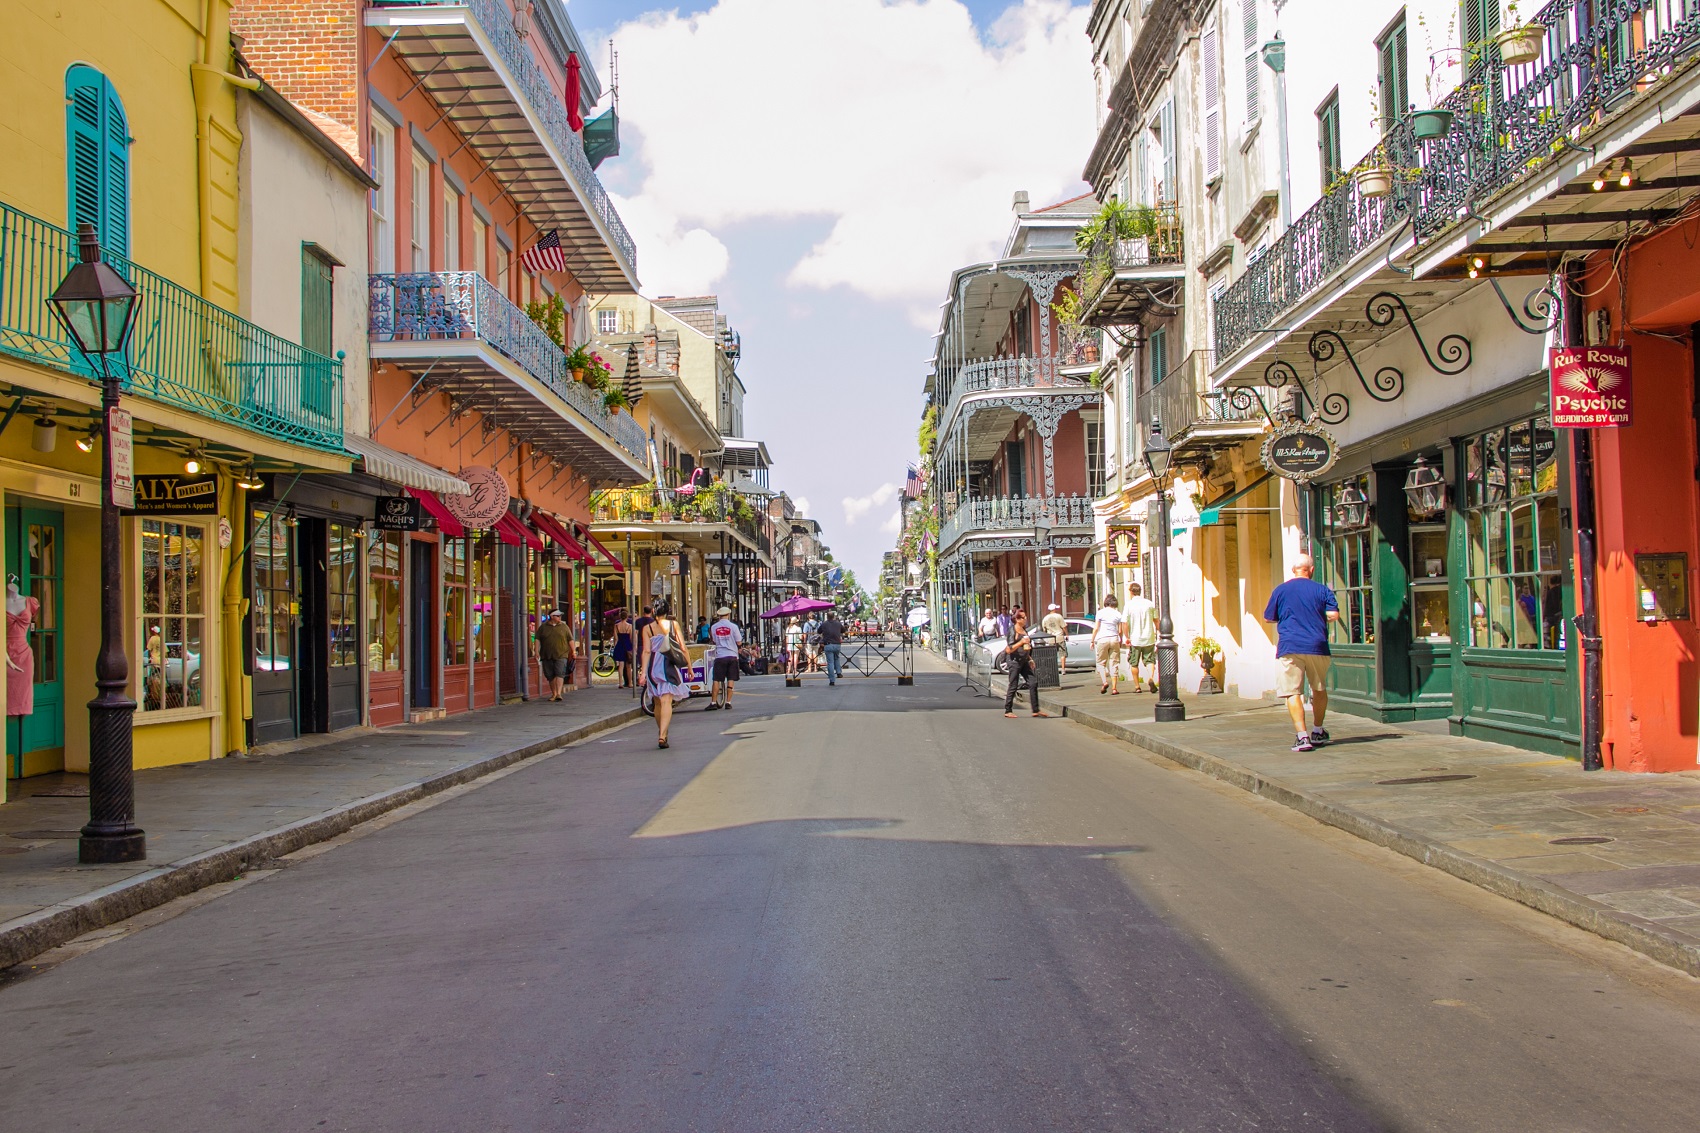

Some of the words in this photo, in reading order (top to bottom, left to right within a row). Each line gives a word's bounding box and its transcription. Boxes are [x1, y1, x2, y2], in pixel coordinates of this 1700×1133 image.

[1555, 354, 1582, 369] Rue
[1587, 350, 1628, 368] Royal
[1555, 394, 1627, 413] Psychic
[1555, 414, 1595, 423] READINGS
[1595, 414, 1608, 423] BY
[1609, 414, 1629, 423] GINA
[117, 452, 128, 464] ZONE
[69, 482, 81, 497] 631
[134, 479, 179, 500] ALY
[179, 483, 212, 497] DIRECT
[137, 502, 154, 510] Men's
[154, 502, 165, 510] and
[192, 502, 215, 511] Apparel
[380, 514, 415, 525] NAGHI'S
[450, 509, 473, 528] FISCHER
[476, 510, 504, 528] GAMBINO
